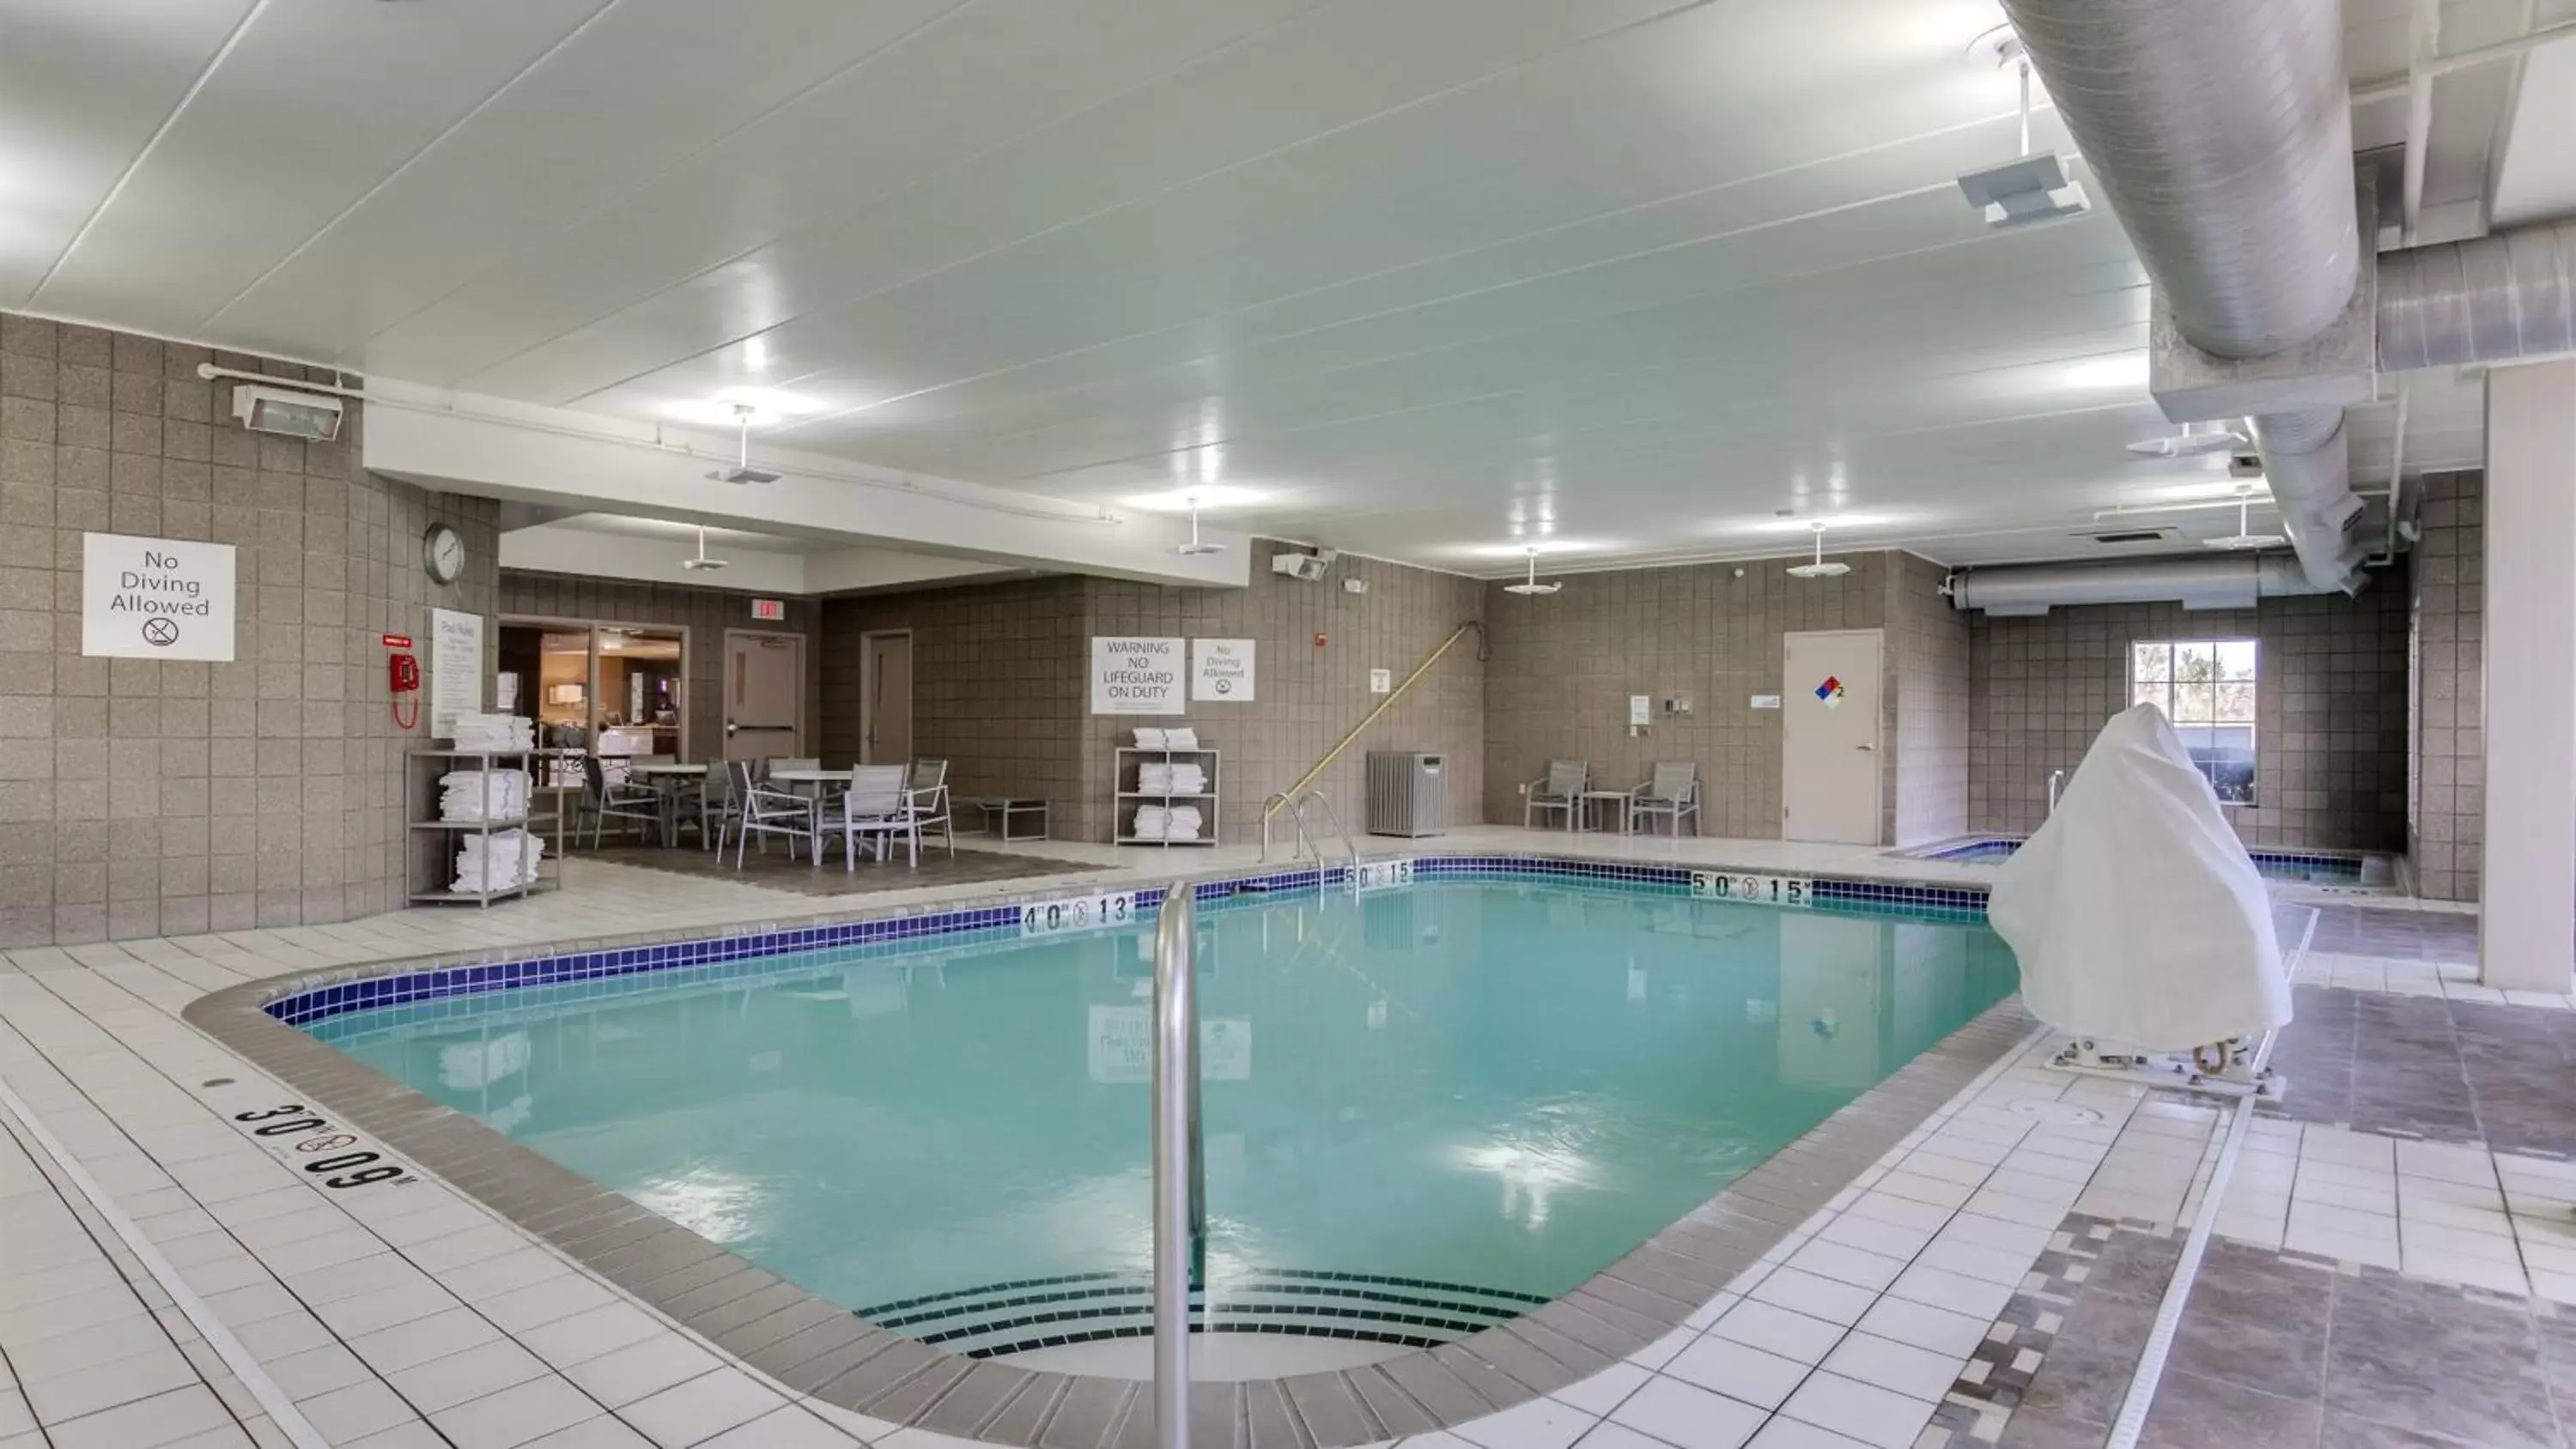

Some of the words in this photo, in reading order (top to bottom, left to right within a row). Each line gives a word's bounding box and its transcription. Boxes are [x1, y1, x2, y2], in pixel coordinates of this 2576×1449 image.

[144, 550, 179, 569] No
[121, 571, 200, 598] Diving
[110, 594, 210, 616] Allowed
[1107, 641, 1170, 654] WARNING
[1127, 657, 1150, 669] NO
[1206, 657, 1241, 669] Diving
[1103, 670, 1174, 684] LIFEGUARD
[1203, 668, 1244, 678] Allowed
[1108, 686, 1129, 698] ON
[1133, 686, 1169, 698] DUTY
